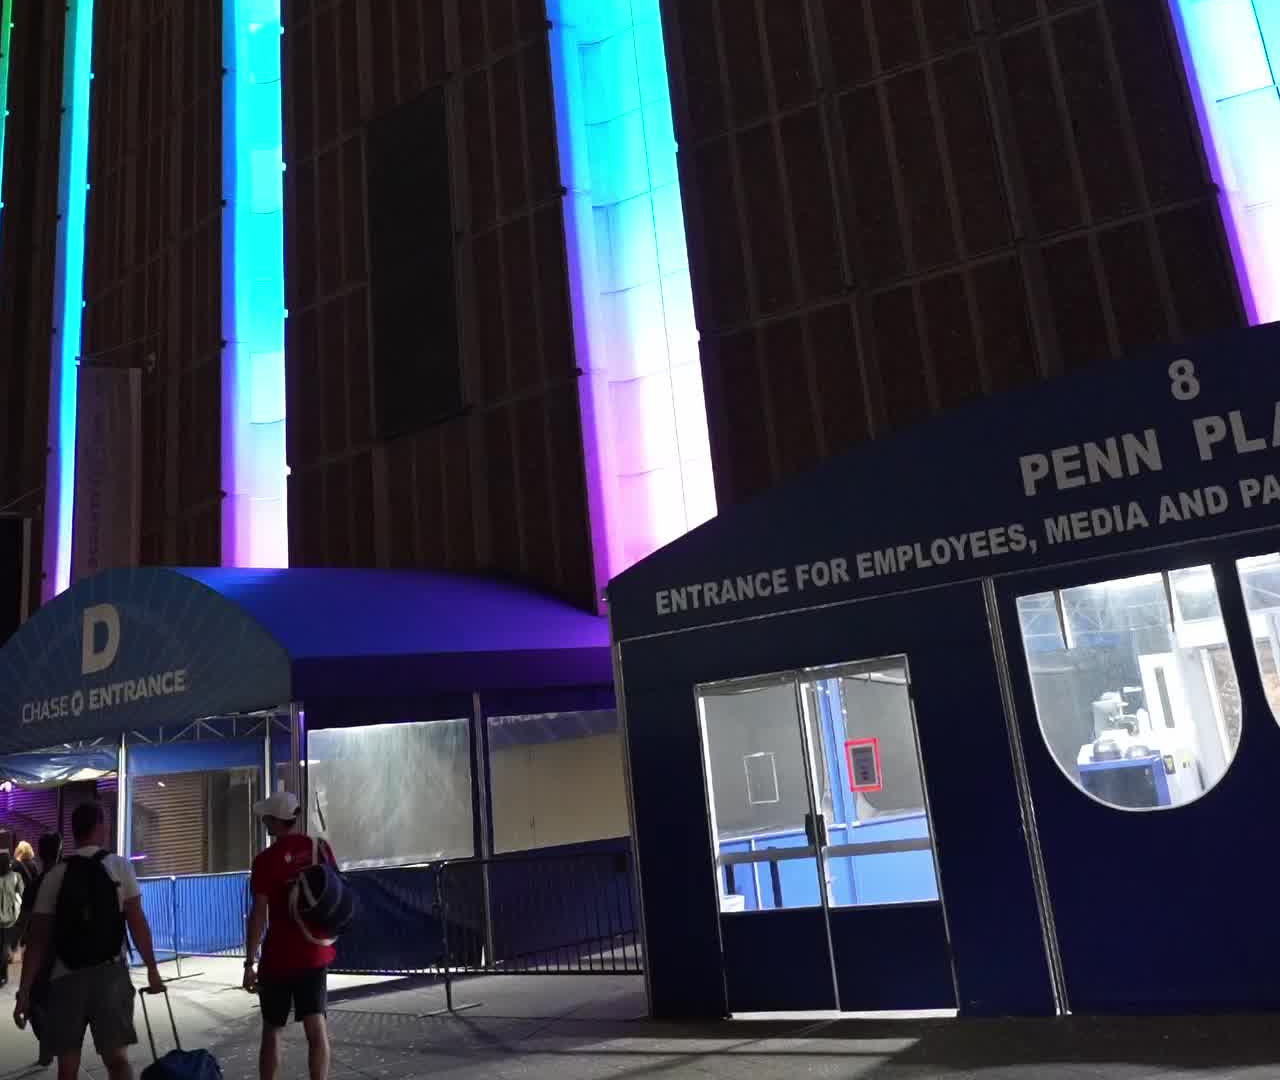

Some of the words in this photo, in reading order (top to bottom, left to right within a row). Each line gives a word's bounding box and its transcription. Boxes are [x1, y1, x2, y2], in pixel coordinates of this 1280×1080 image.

[1168, 359, 1201, 402] 8
[1019, 427, 1163, 498] PENN
[655, 567, 789, 616] ENTRANCE
[795, 557, 849, 591] FOR
[856, 523, 1038, 579] EMPLOYEES,
[1045, 502, 1149, 546] MEDIA
[1157, 485, 1230, 524] AND
[81, 603, 121, 675] D
[21, 695, 69, 723] CHASE
[89, 670, 187, 711] ENTRANCE
